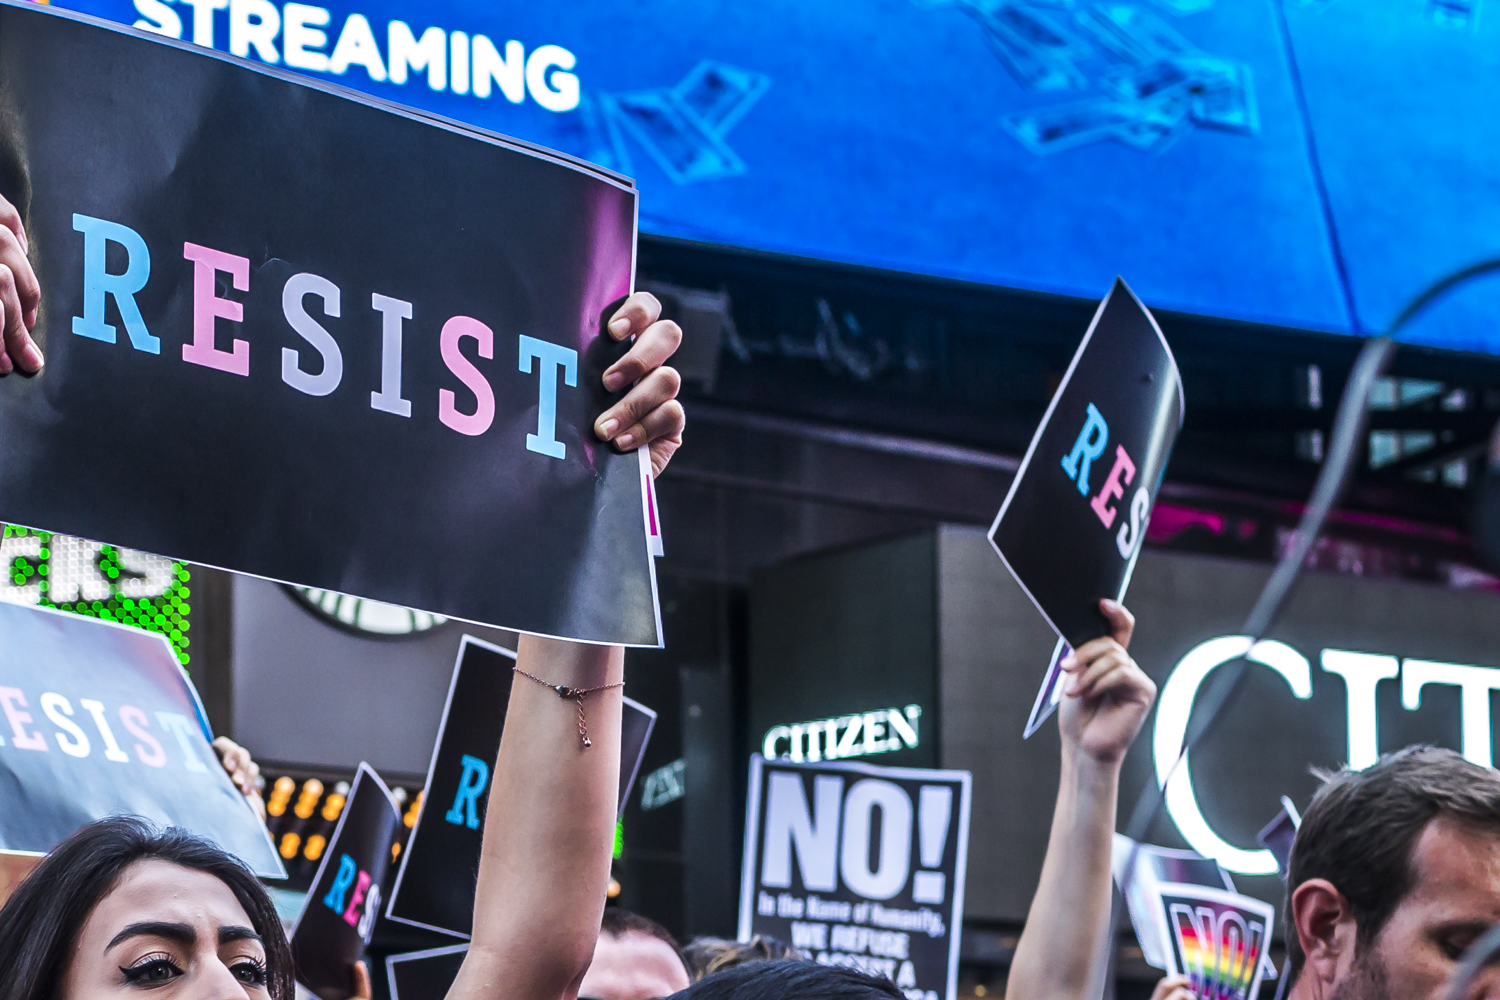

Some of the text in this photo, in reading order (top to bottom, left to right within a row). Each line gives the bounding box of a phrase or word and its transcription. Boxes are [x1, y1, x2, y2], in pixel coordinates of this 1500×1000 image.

[132, 0, 581, 112] STREAMING
[72, 213, 577, 459] RESIST
[763, 704, 921, 763] CITIZEN
[762, 771, 952, 904] NO!
